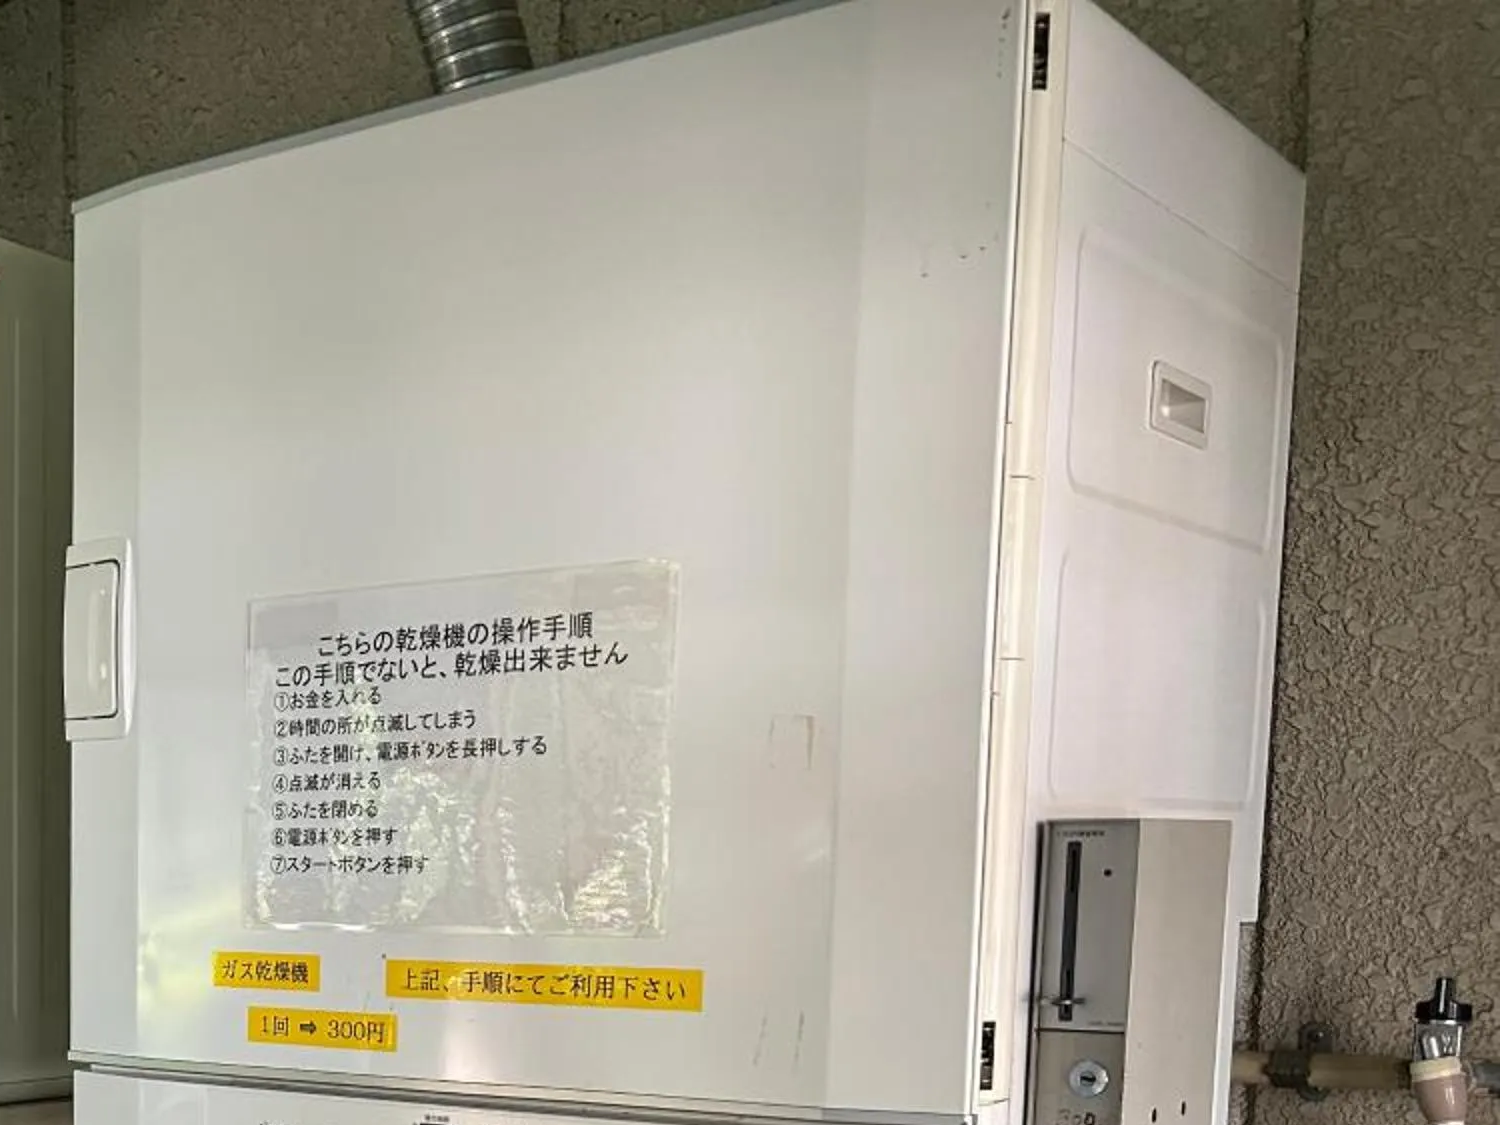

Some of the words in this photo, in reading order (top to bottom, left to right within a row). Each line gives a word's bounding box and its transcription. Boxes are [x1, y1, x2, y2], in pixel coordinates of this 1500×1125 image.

[318, 611, 594, 657] こちらの乾燥機の操作手順
[275, 642, 629, 687] この手順でないと、乾燥出来ません
[275, 686, 382, 711] ①お金を入れる
[275, 710, 477, 738] ②時間の所が点滅してしまう
[273, 771, 381, 794] ④点滅が消える
[272, 800, 379, 821] ⑤ふたを閉める
[270, 855, 430, 875] ⑦スタートボタンを押す
[221, 958, 309, 985] ガス乾燥機
[403, 967, 687, 1001] 上記、手順にてご利用下さい
[260, 1015, 290, 1037] 1回
[327, 1019, 386, 1044] 300円
